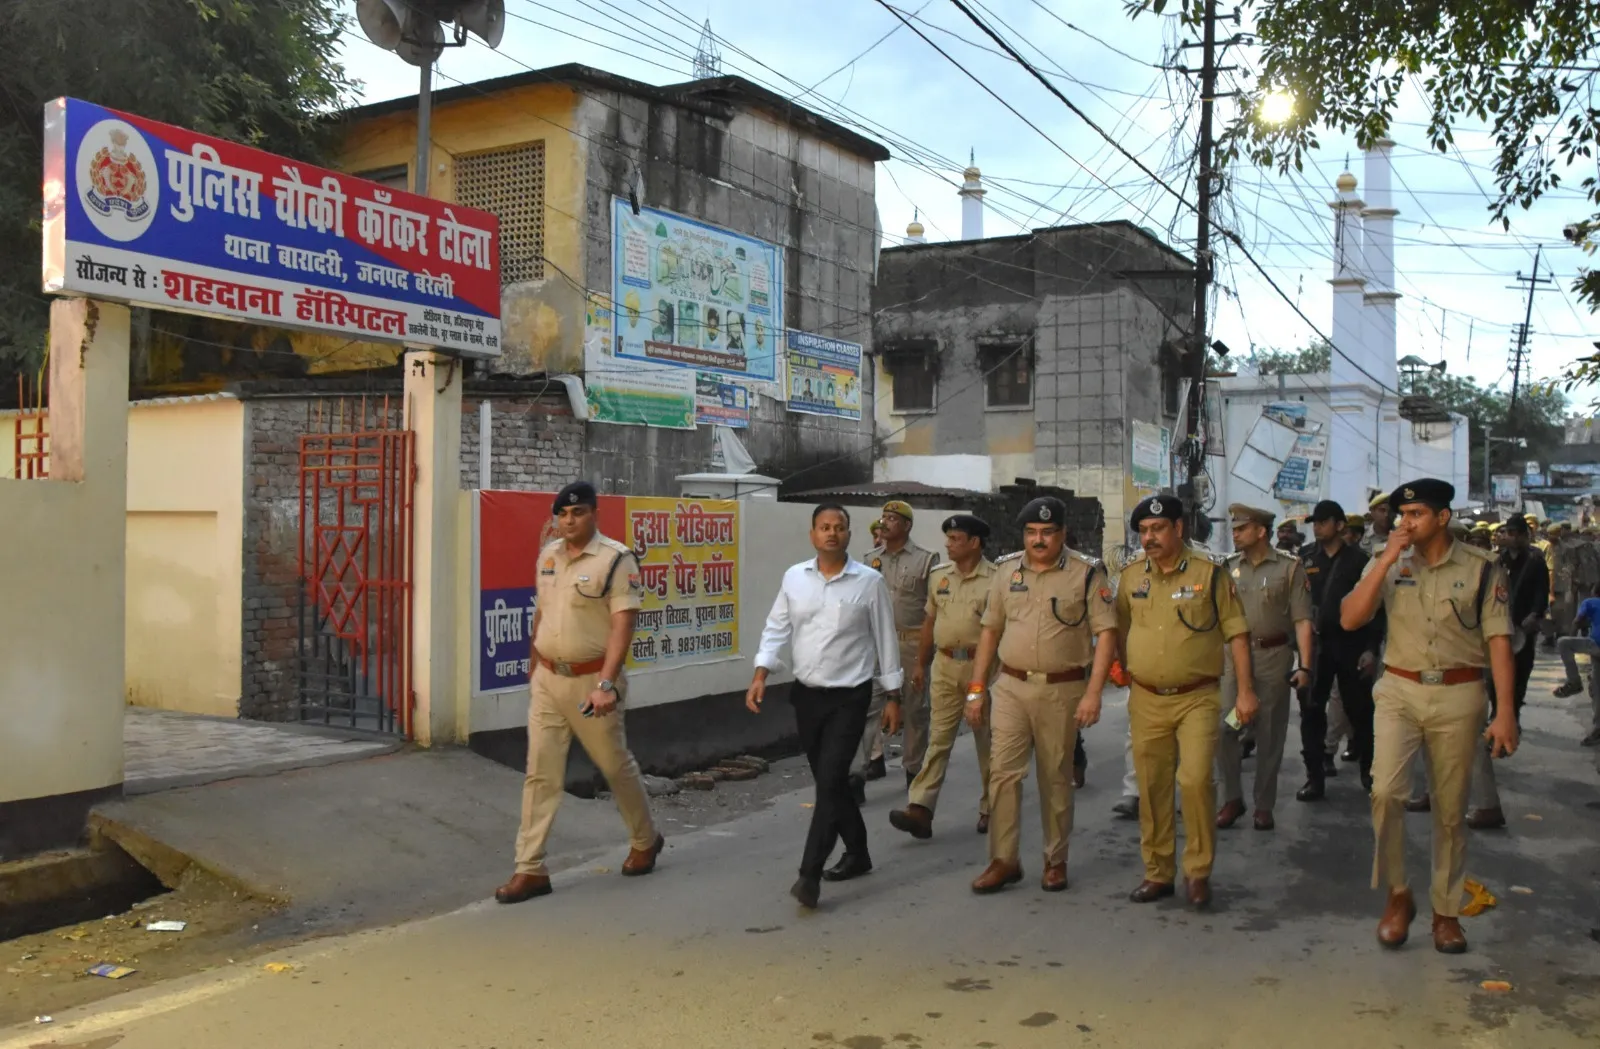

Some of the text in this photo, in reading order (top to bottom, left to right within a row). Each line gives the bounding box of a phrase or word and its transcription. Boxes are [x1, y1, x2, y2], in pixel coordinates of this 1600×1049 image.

[165, 142, 263, 222] पुलिस
[272, 165, 347, 238] चौकी
[436, 208, 492, 270] टोला
[224, 234, 455, 299] थाना बारादरी, जनपद बरेली
[76, 255, 128, 285] सौजन्य
[132, 264, 146, 289] से
[161, 270, 284, 316] शहदाना
[293, 287, 408, 335] हॉस्पिटल
[797, 334, 836, 352] INSPIRATION
[836, 343, 860, 357] CLASSES
[631, 502, 735, 557] दुआ मेडिकल
[702, 553, 734, 593] शॉप
[484, 598, 523, 658] पुलिस
[637, 603, 735, 631] गतपुर तिराहा, पुराना शहर
[632, 631, 733, 659] बरेली, मो. 9837467650
